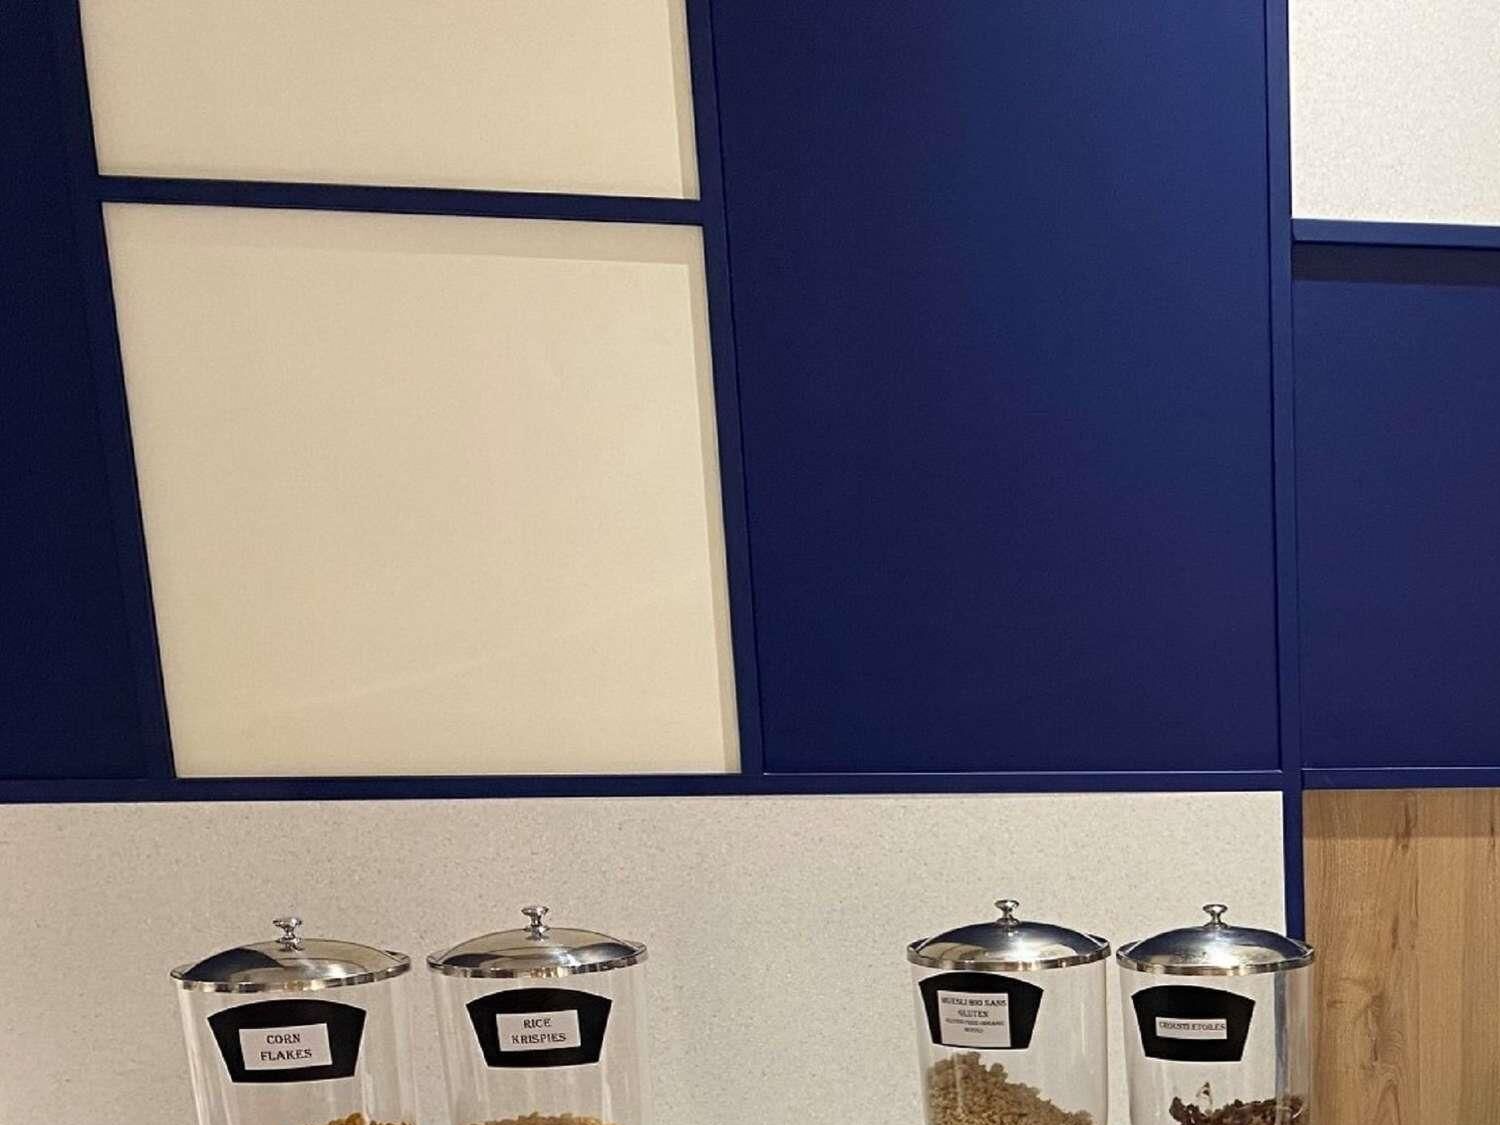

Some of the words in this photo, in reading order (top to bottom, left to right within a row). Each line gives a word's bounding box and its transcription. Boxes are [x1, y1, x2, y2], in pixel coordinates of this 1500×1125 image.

[984, 999, 1007, 1007] SANS
[523, 1018, 552, 1029] RICE
[266, 1033, 301, 1045] CORN
[511, 1032, 567, 1045] KRISPIES
[260, 1048, 313, 1062] FLAKES
